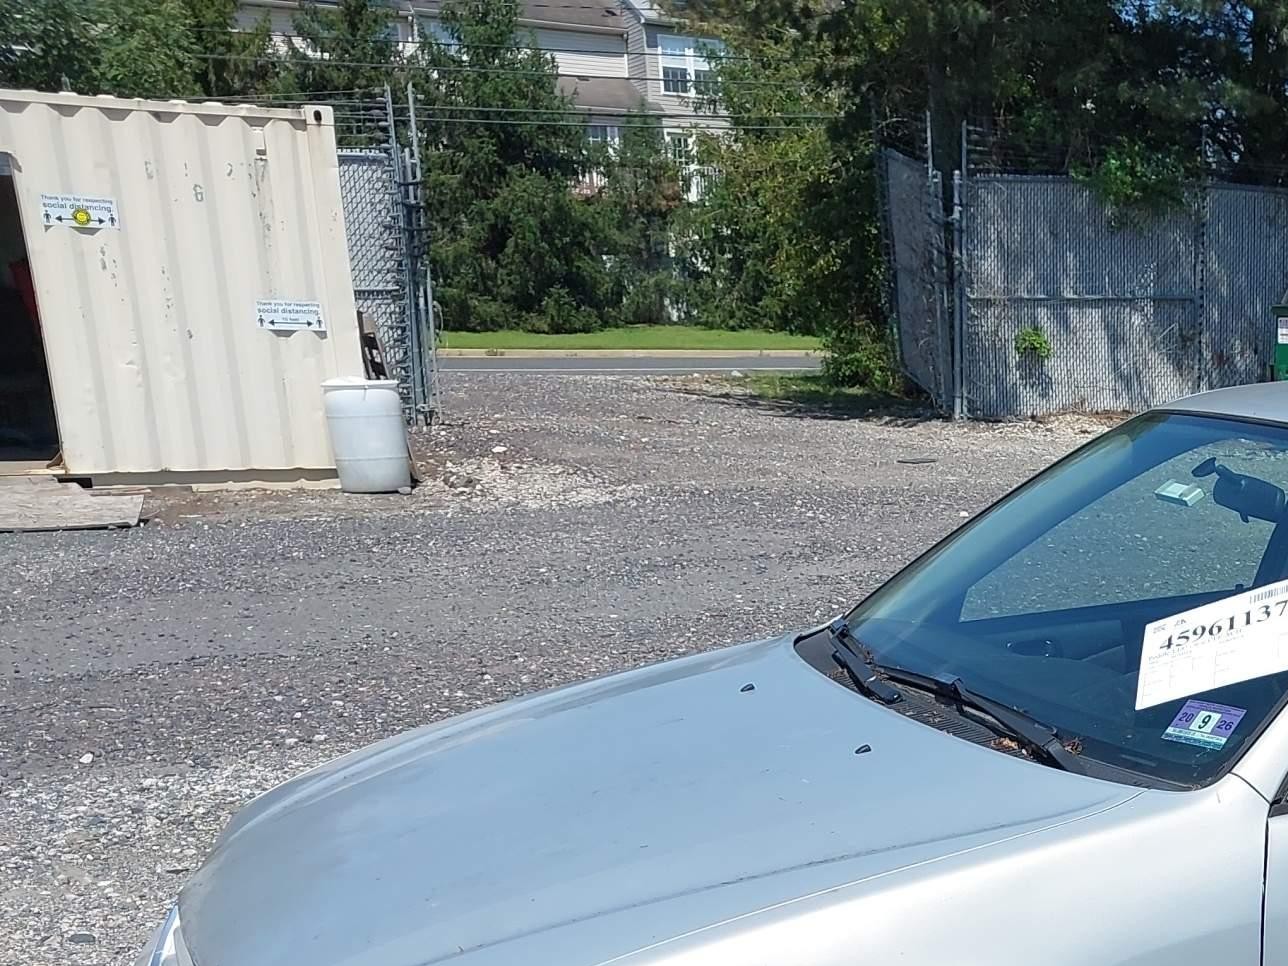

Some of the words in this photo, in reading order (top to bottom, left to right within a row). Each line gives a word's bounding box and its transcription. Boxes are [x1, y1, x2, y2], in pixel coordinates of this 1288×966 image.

[1160, 600, 1288, 650] 45961137
[1178, 712, 1194, 723] 20
[1198, 714, 1212, 730] 9
[1217, 720, 1234, 731] 26
